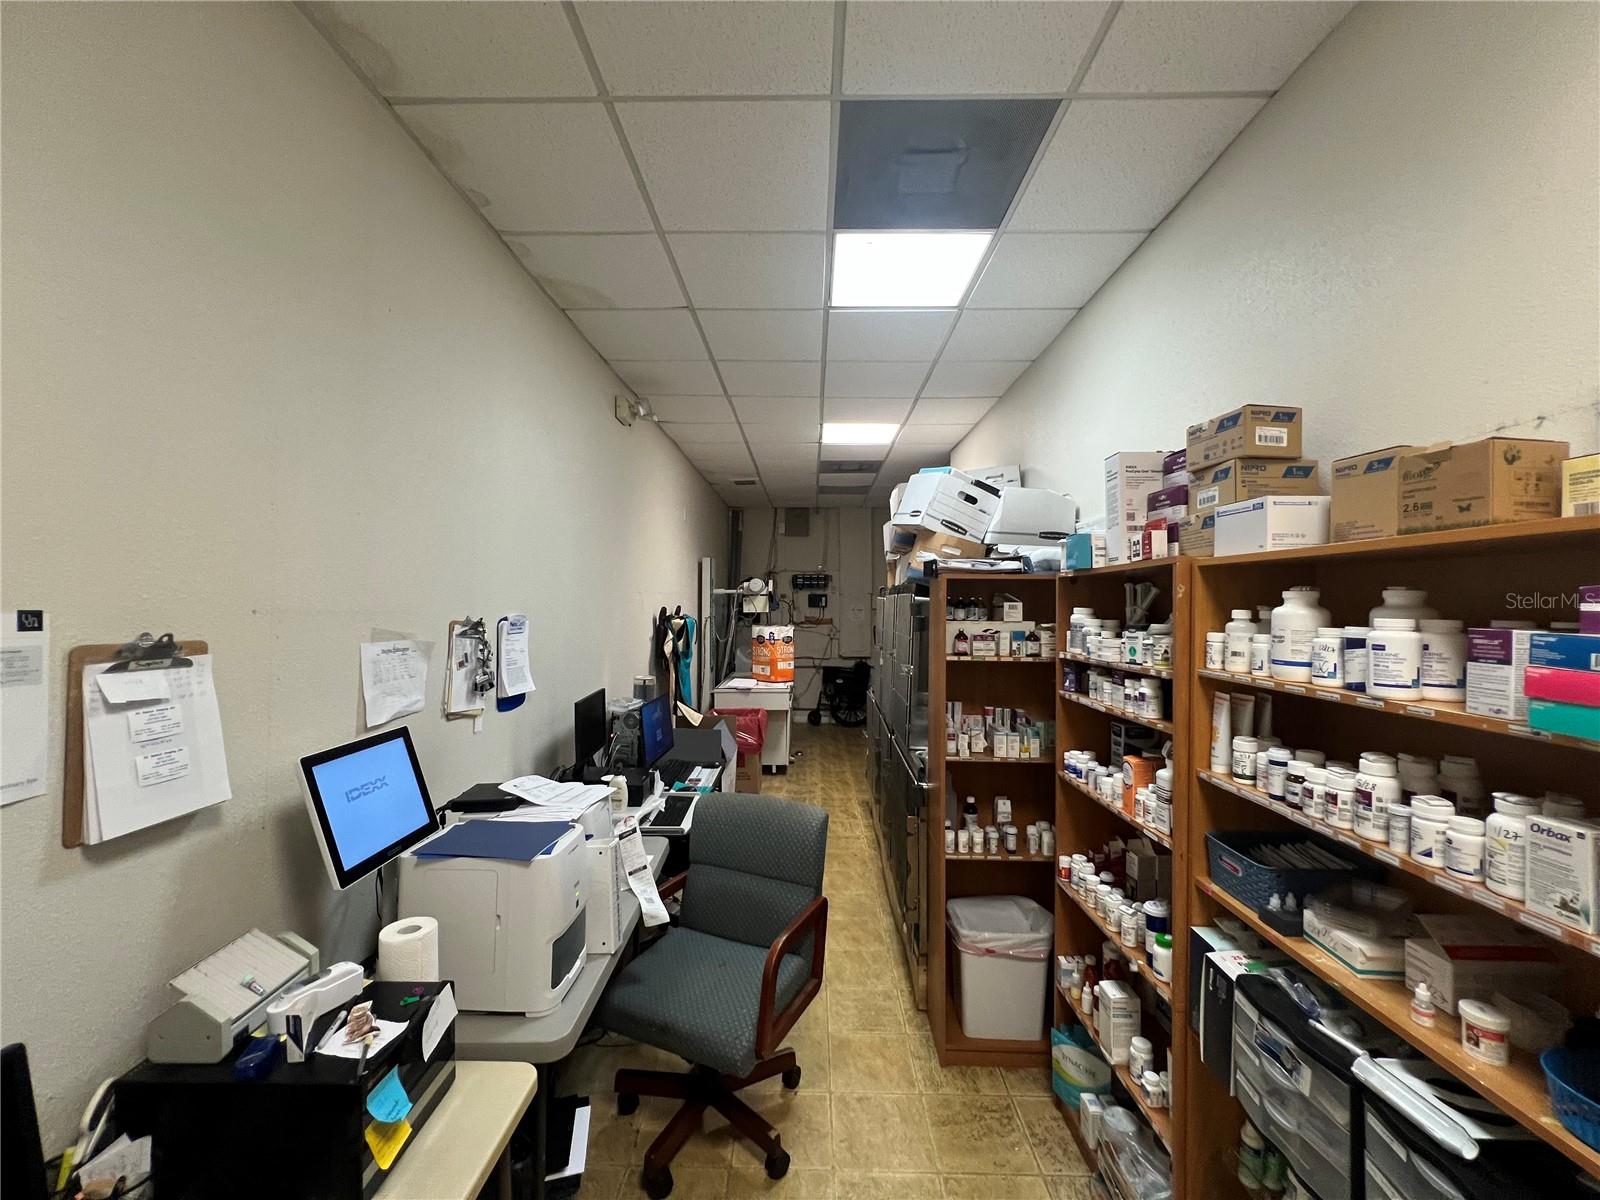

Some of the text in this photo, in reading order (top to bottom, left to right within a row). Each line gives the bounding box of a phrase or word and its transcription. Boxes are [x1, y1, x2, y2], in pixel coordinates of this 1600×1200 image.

[1240, 464, 1267, 472] NIPRO
[345, 775, 389, 803] IDEXX
[1530, 823, 1572, 843] Orbax
